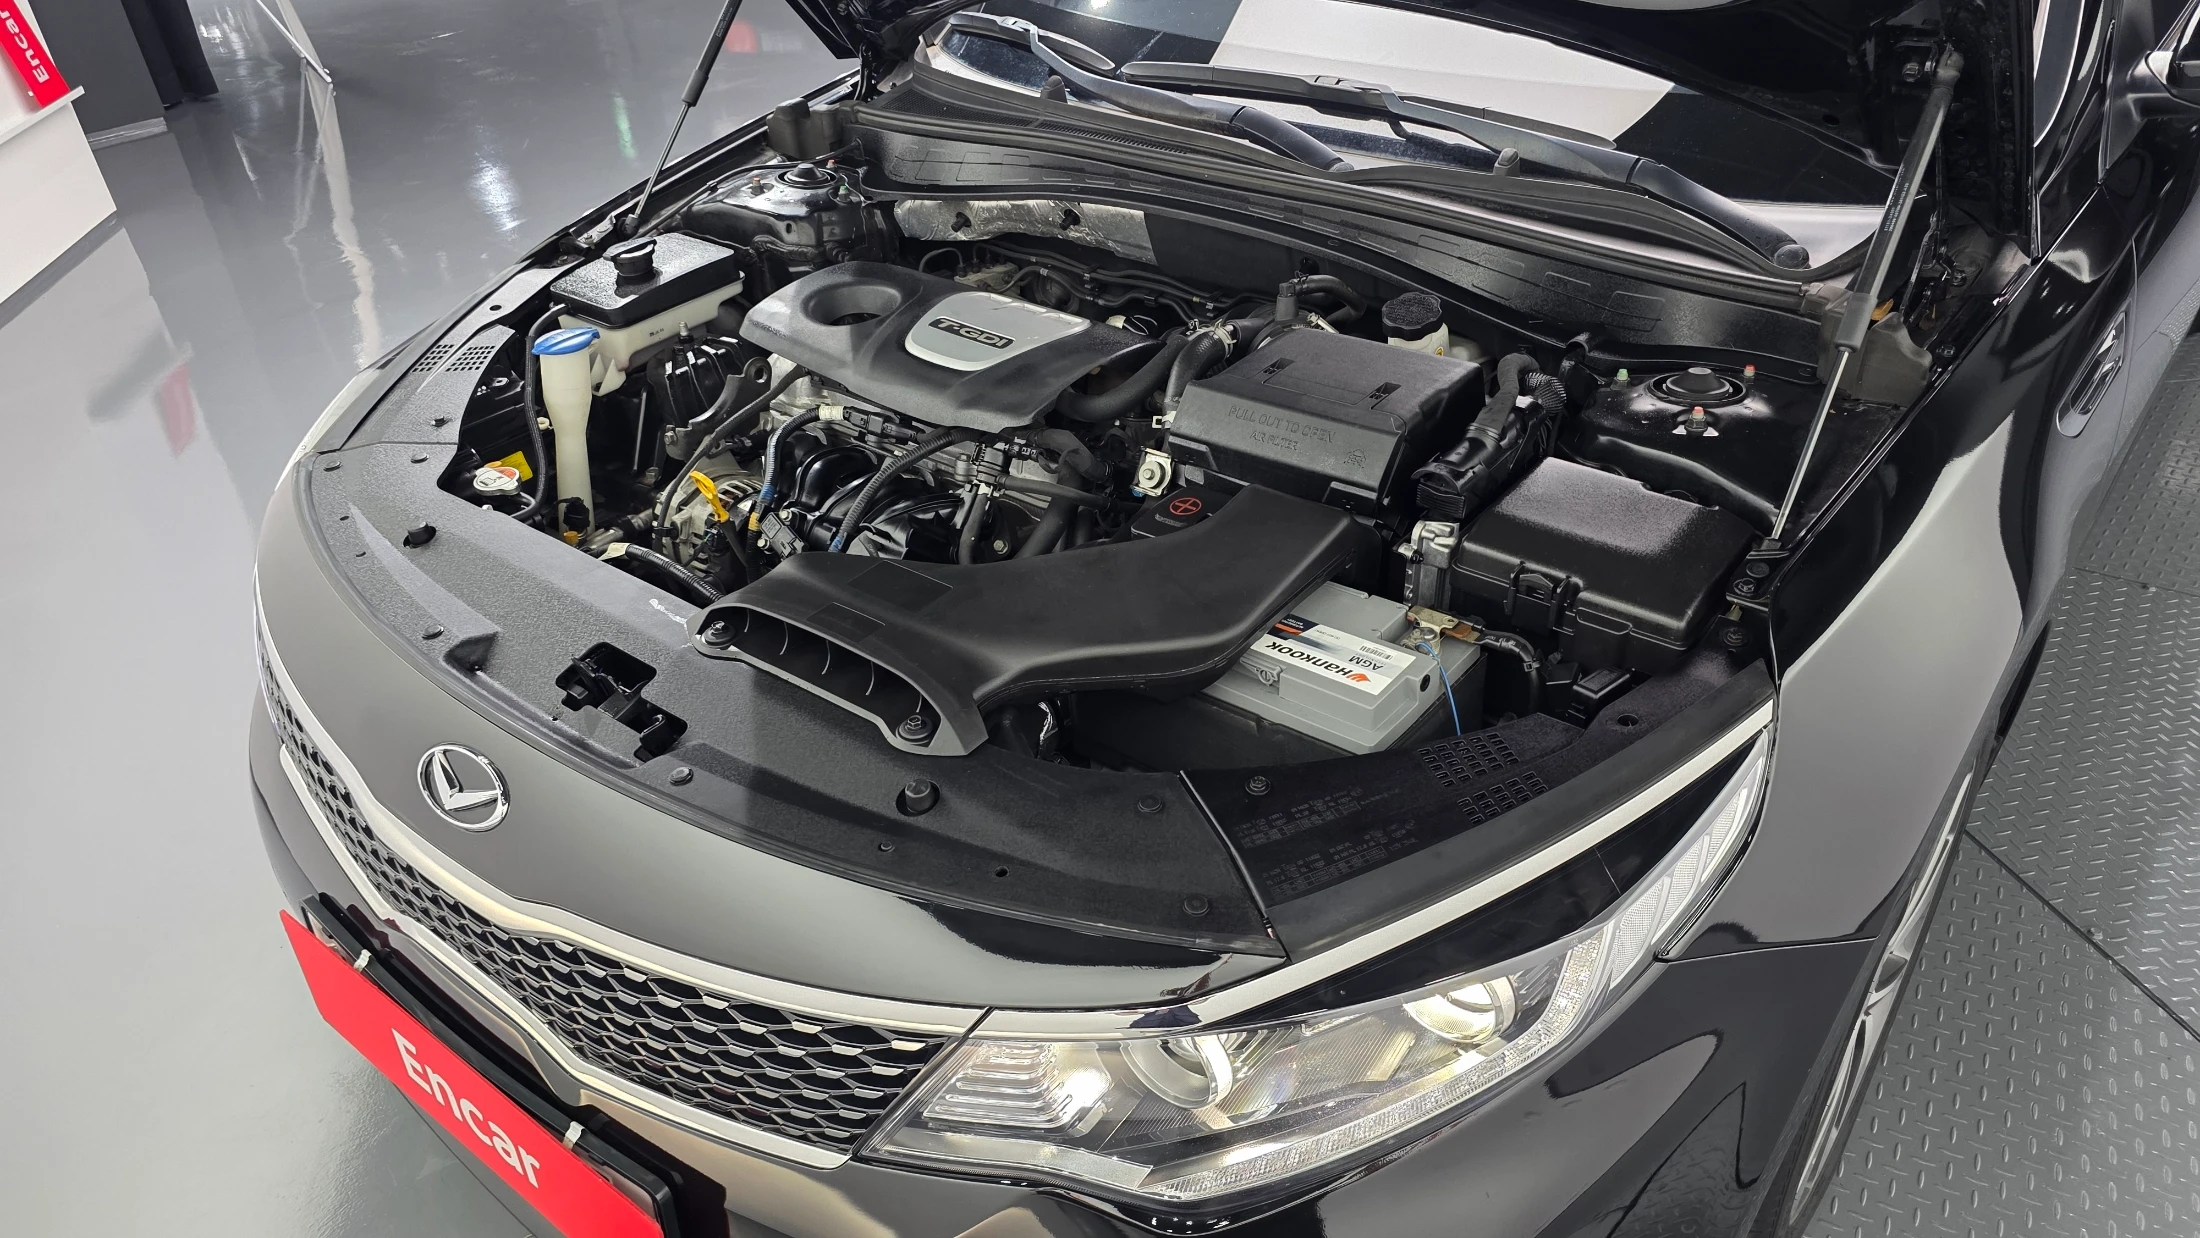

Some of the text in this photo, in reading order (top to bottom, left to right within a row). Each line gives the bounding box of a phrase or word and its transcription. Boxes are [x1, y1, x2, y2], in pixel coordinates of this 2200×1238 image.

[0, 10, 50, 84] Encar
[1228, 405, 1336, 443] PULL OUT TO OPEN
[1250, 430, 1299, 451] AIR FILTER
[1348, 655, 1384, 671] AGM
[391, 1027, 541, 1189] Encar
